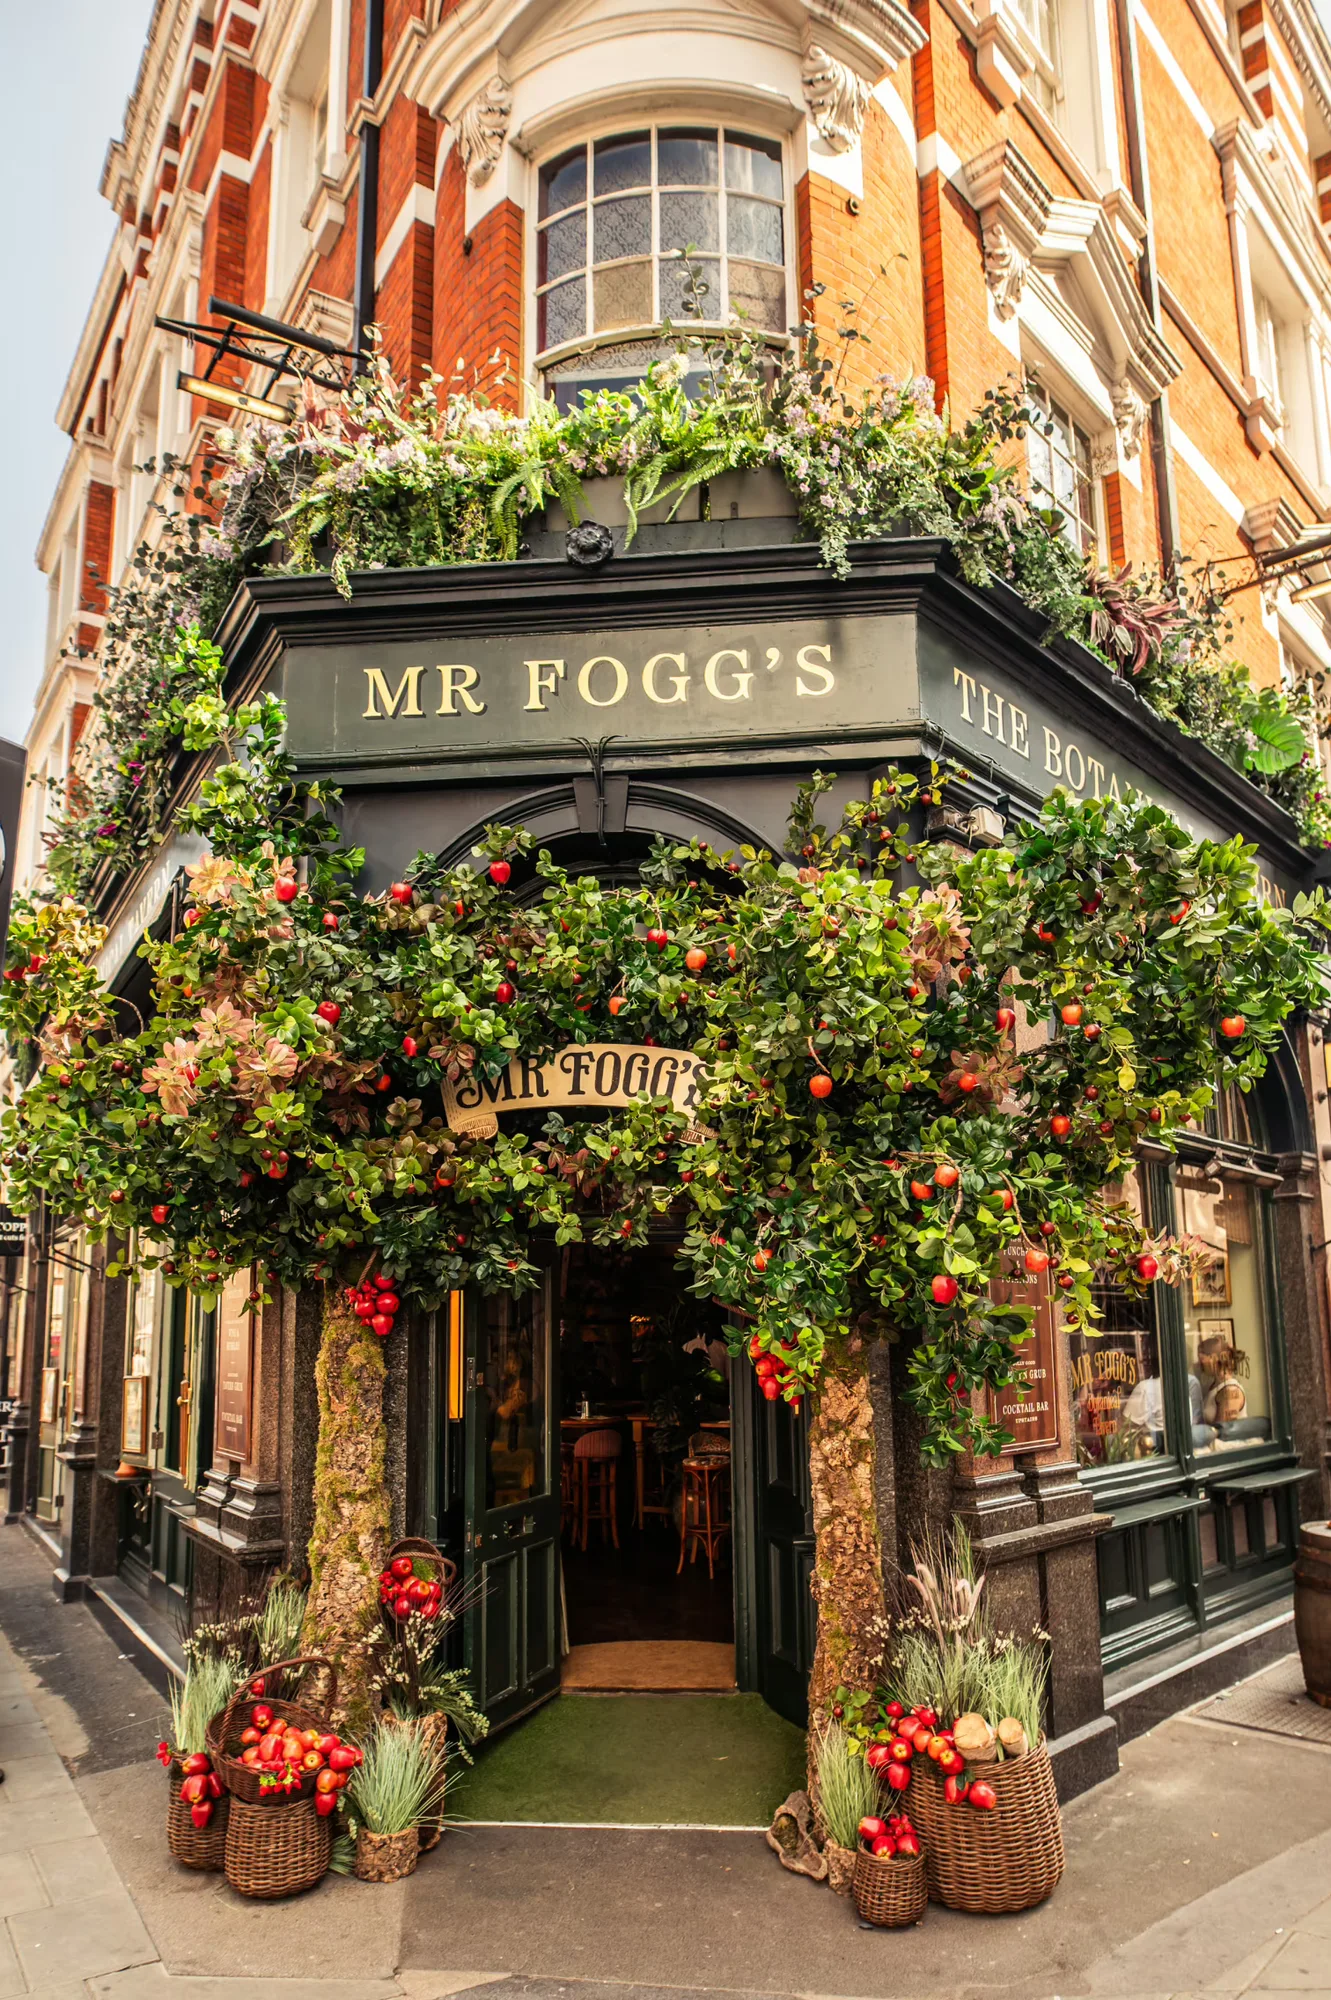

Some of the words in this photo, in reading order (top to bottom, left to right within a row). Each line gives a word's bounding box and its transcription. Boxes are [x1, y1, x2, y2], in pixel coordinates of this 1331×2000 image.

[362, 664, 487, 719] MR
[523, 644, 837, 711] FOGG'S
[953, 667, 1031, 760] THE
[456, 1053, 550, 1109] MR
[1029, 1368, 1047, 1380] GRUB
[1071, 1352, 1094, 1390] MR
[1002, 1402, 1035, 1415] COCKTAIL
[1036, 1401, 1049, 1412] BAR
